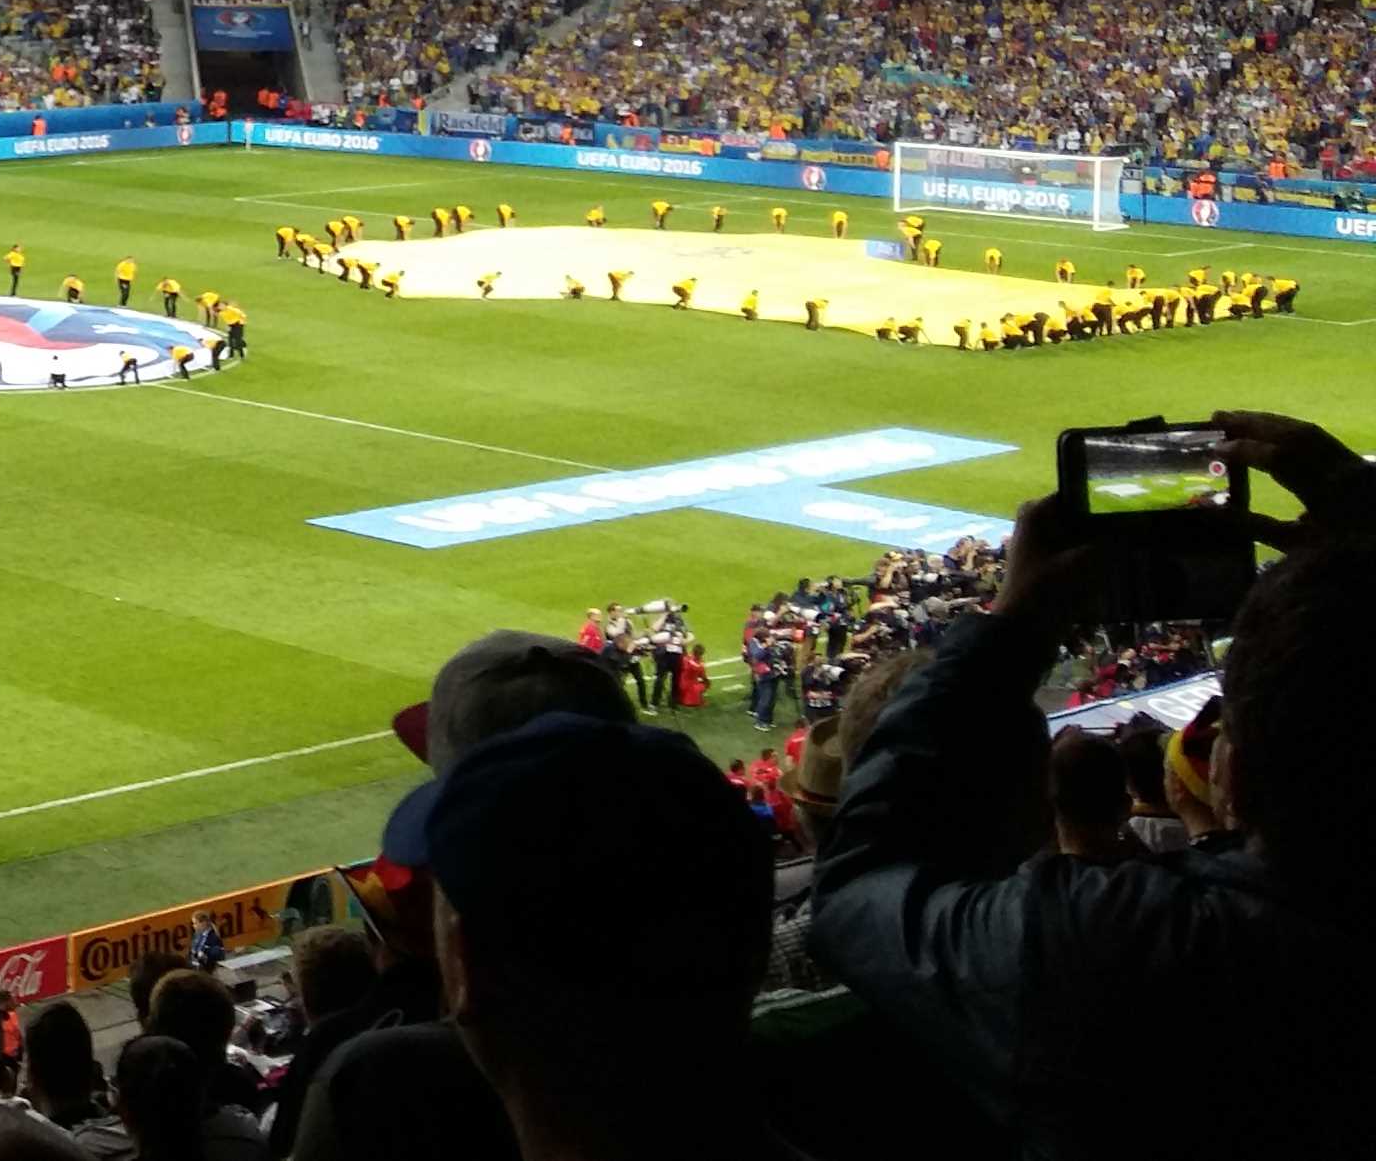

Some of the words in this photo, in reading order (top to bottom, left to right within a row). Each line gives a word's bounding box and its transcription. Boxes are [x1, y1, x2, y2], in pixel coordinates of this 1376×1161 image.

[14, 139, 45, 154] UEFA
[46, 137, 77, 152] EURO
[79, 135, 109, 149] 2016
[265, 129, 301, 144] UEFA
[302, 131, 342, 148] EURO
[343, 135, 379, 150] 2016
[578, 151, 618, 167] UEFA
[620, 154, 662, 172] EURO
[663, 159, 702, 175] 2016
[923, 181, 970, 200] UEFA
[972, 185, 1020, 205] EURO
[1024, 190, 1070, 211] 2016
